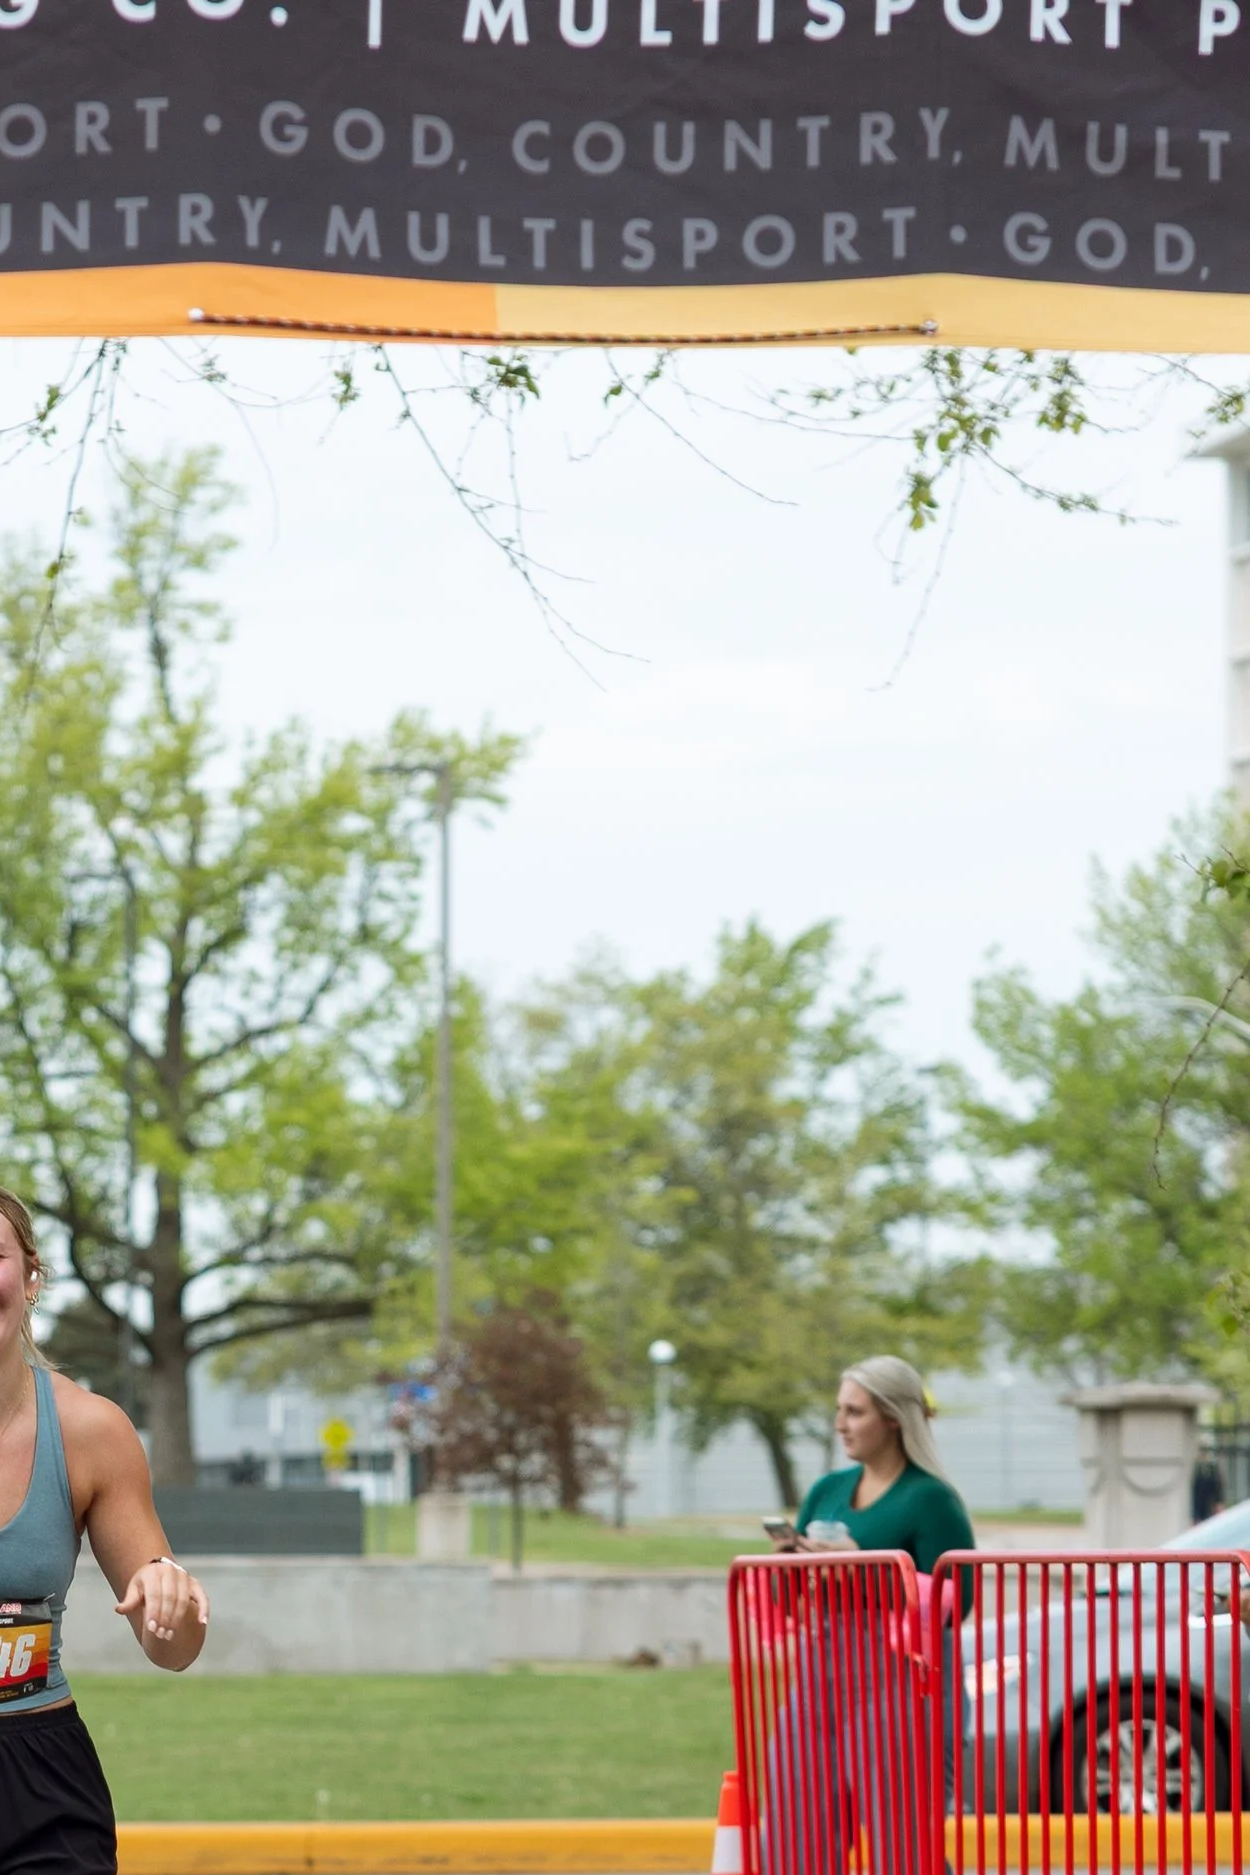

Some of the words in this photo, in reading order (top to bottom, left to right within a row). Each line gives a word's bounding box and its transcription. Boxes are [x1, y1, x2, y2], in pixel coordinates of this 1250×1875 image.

[461, 0, 1135, 50] MULTISPORT
[258, 99, 468, 174] GOD,
[510, 107, 963, 176] COUNTRY,
[1003, 114, 1232, 181] MULT
[322, 204, 917, 274] MULTISPORT
[1002, 212, 1211, 282] GOD,
